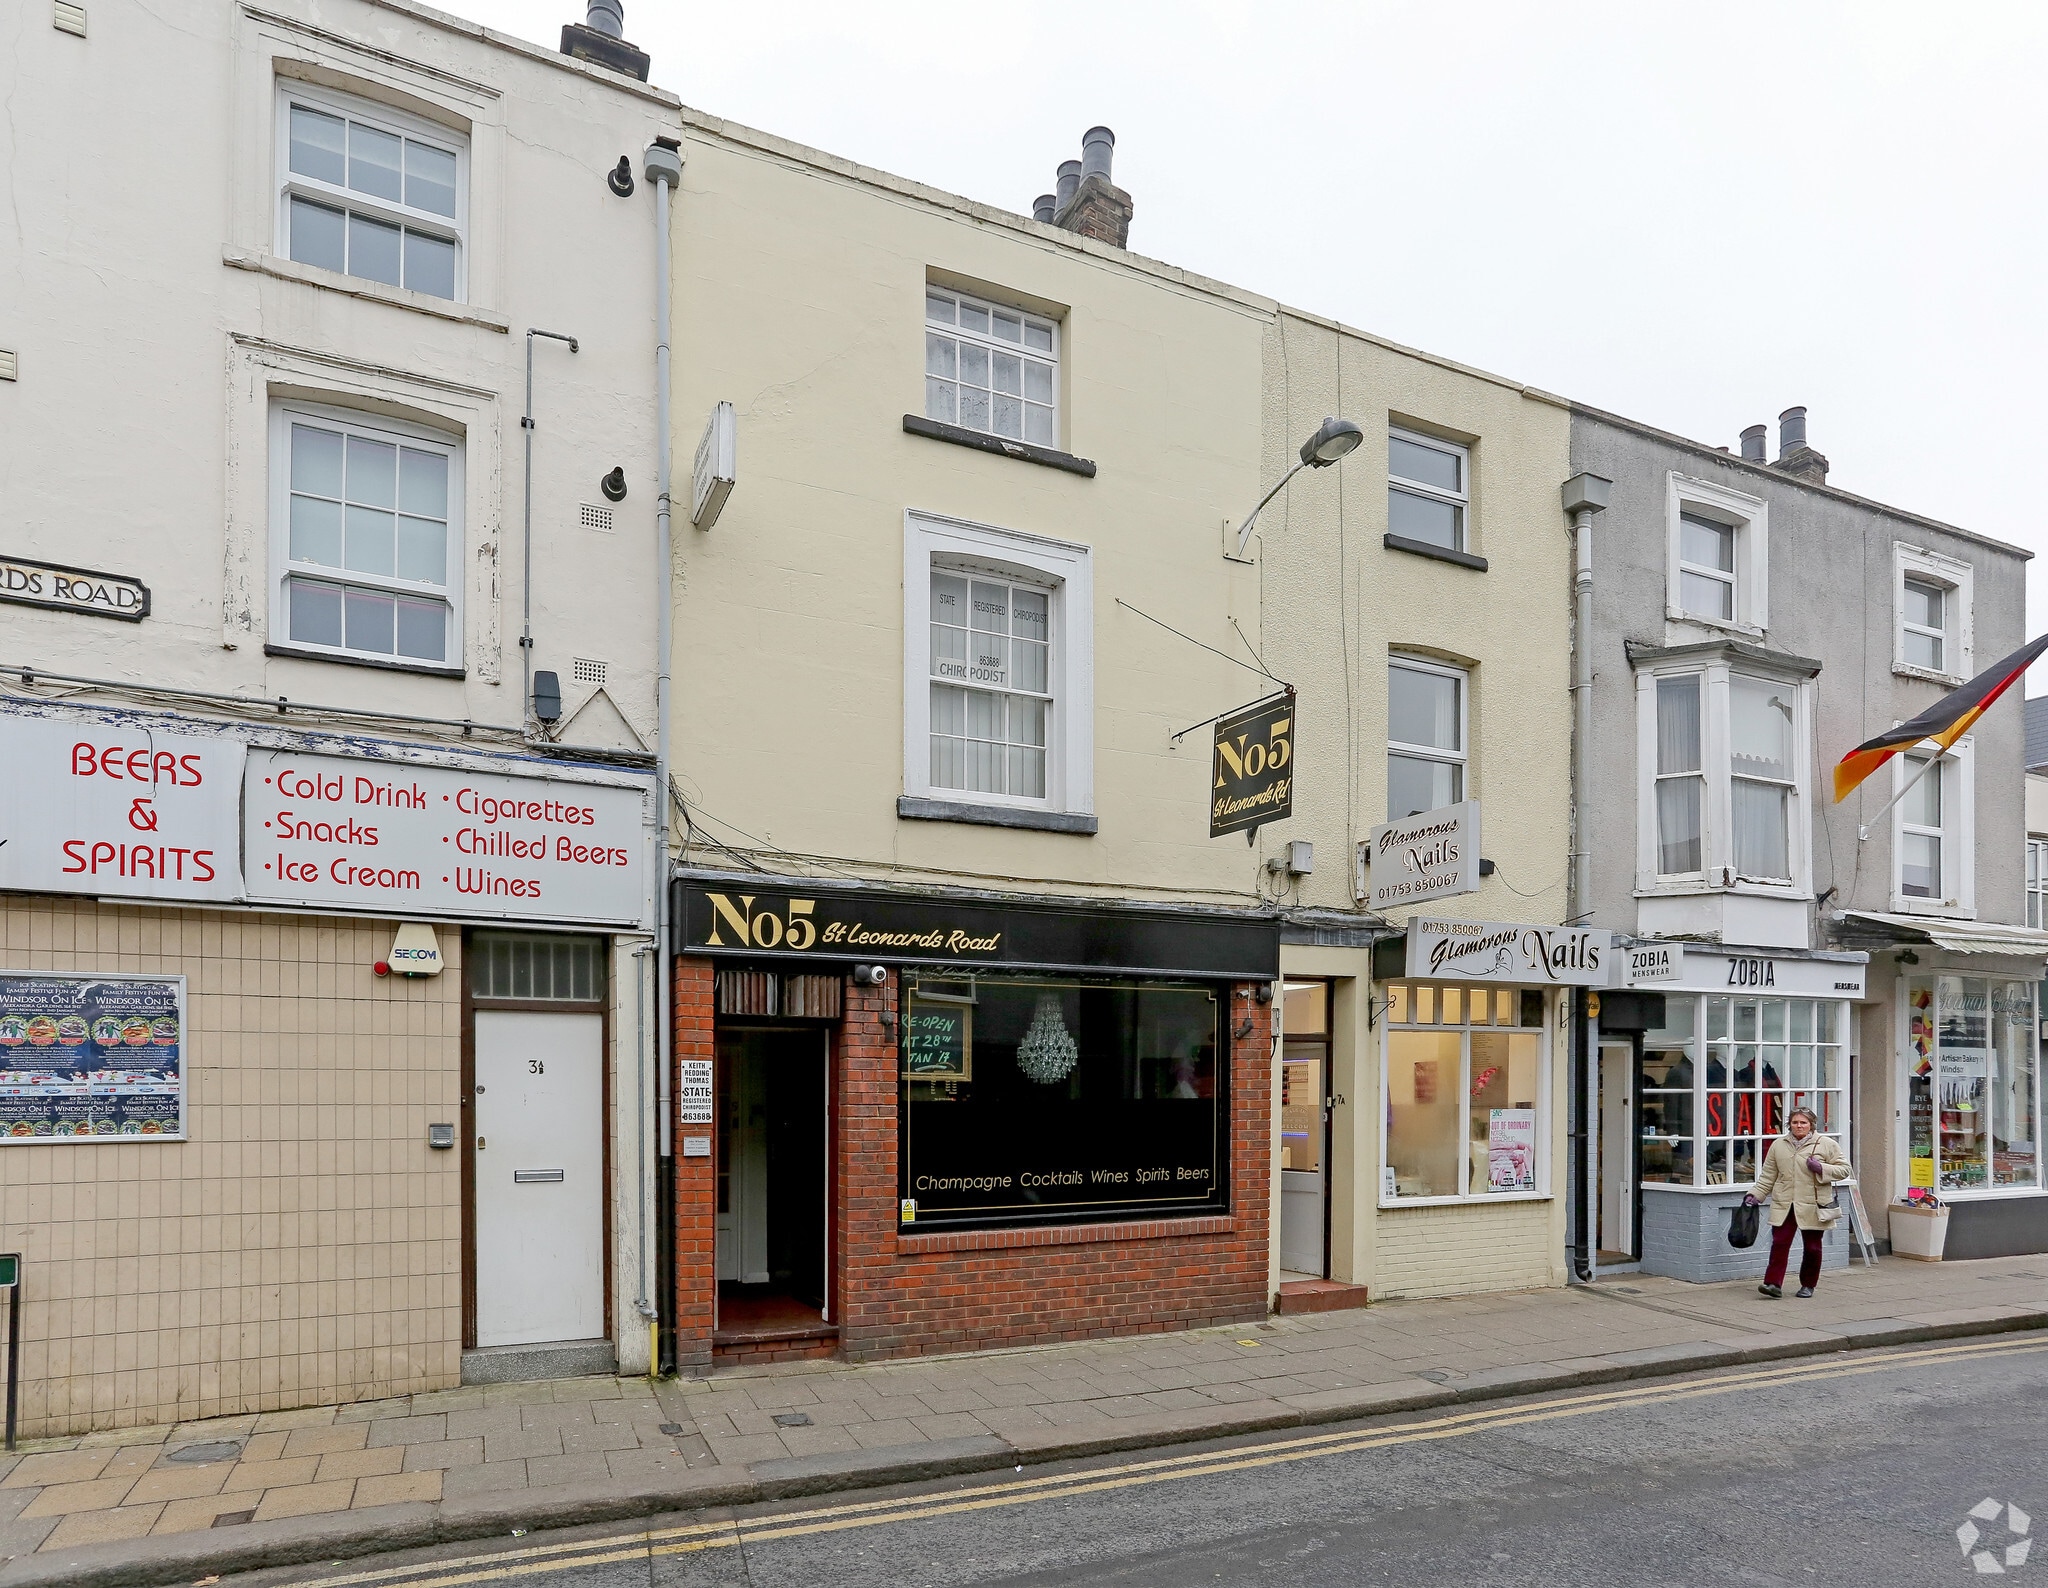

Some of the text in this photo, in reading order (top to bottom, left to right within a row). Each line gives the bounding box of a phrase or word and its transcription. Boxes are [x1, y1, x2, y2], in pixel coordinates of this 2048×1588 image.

[53, 576, 137, 607] ROAD
[939, 594, 956, 606] STATE
[974, 600, 1006, 616] REGISTERED
[1013, 609, 1048, 623] CHIROPODIST
[72, 742, 202, 787] BEERS
[1214, 718, 1290, 788] No5
[277, 770, 426, 810] Cold Drink
[1224, 783, 1273, 816] Leonards
[1272, 777, 1291, 804] Rd
[128, 798, 158, 832] &
[456, 788, 595, 826] Cigarettes
[276, 811, 379, 846] Snacks
[1379, 818, 1460, 855] Glamorous
[62, 840, 215, 882] SPIRITS
[456, 828, 628, 867] Chilled Beers
[1403, 839, 1460, 875] Nails
[278, 853, 420, 890] Ice Cream
[456, 867, 541, 898] Wines
[1378, 871, 1460, 899] 01753 850067
[705, 893, 816, 950] No5
[1421, 921, 1483, 936] 01753 850067
[822, 922, 1001, 953] St Leonards Road
[1429, 928, 1518, 975] Glamorous
[394, 949, 437, 960] SECOM
[1521, 929, 1600, 981] Nails
[1632, 950, 1669, 968] ZOBIA
[1632, 968, 1670, 978] MENSWEAR
[1727, 958, 1775, 987] ZOBIA
[0, 995, 87, 1004] WINDSOR ON ICE
[95, 996, 142, 1005] WINDSOR
[144, 997, 161, 1006] ON
[909, 1053, 932, 1063] JAN
[684, 1087, 710, 1097] STATE
[683, 1112, 711, 1120] 863688
[916, 1166, 1209, 1192] Champagne Cocktails Wines Spirits Beers
